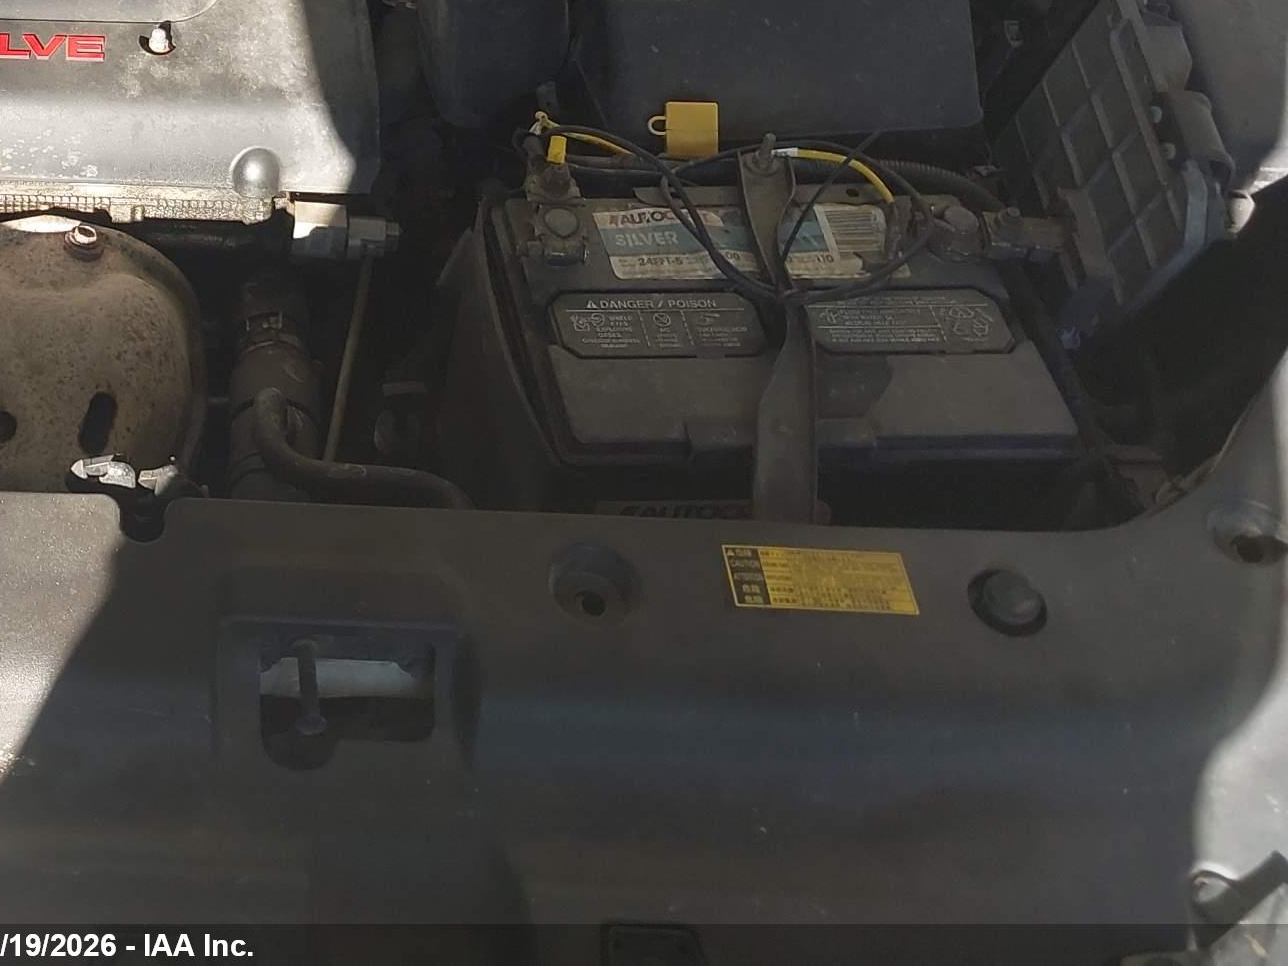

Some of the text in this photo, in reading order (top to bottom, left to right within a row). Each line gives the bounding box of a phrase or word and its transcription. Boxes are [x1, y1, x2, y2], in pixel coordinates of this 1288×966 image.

[615, 233, 679, 248] SILVER
[599, 299, 654, 309] DANGER
[667, 299, 718, 308] POISON
